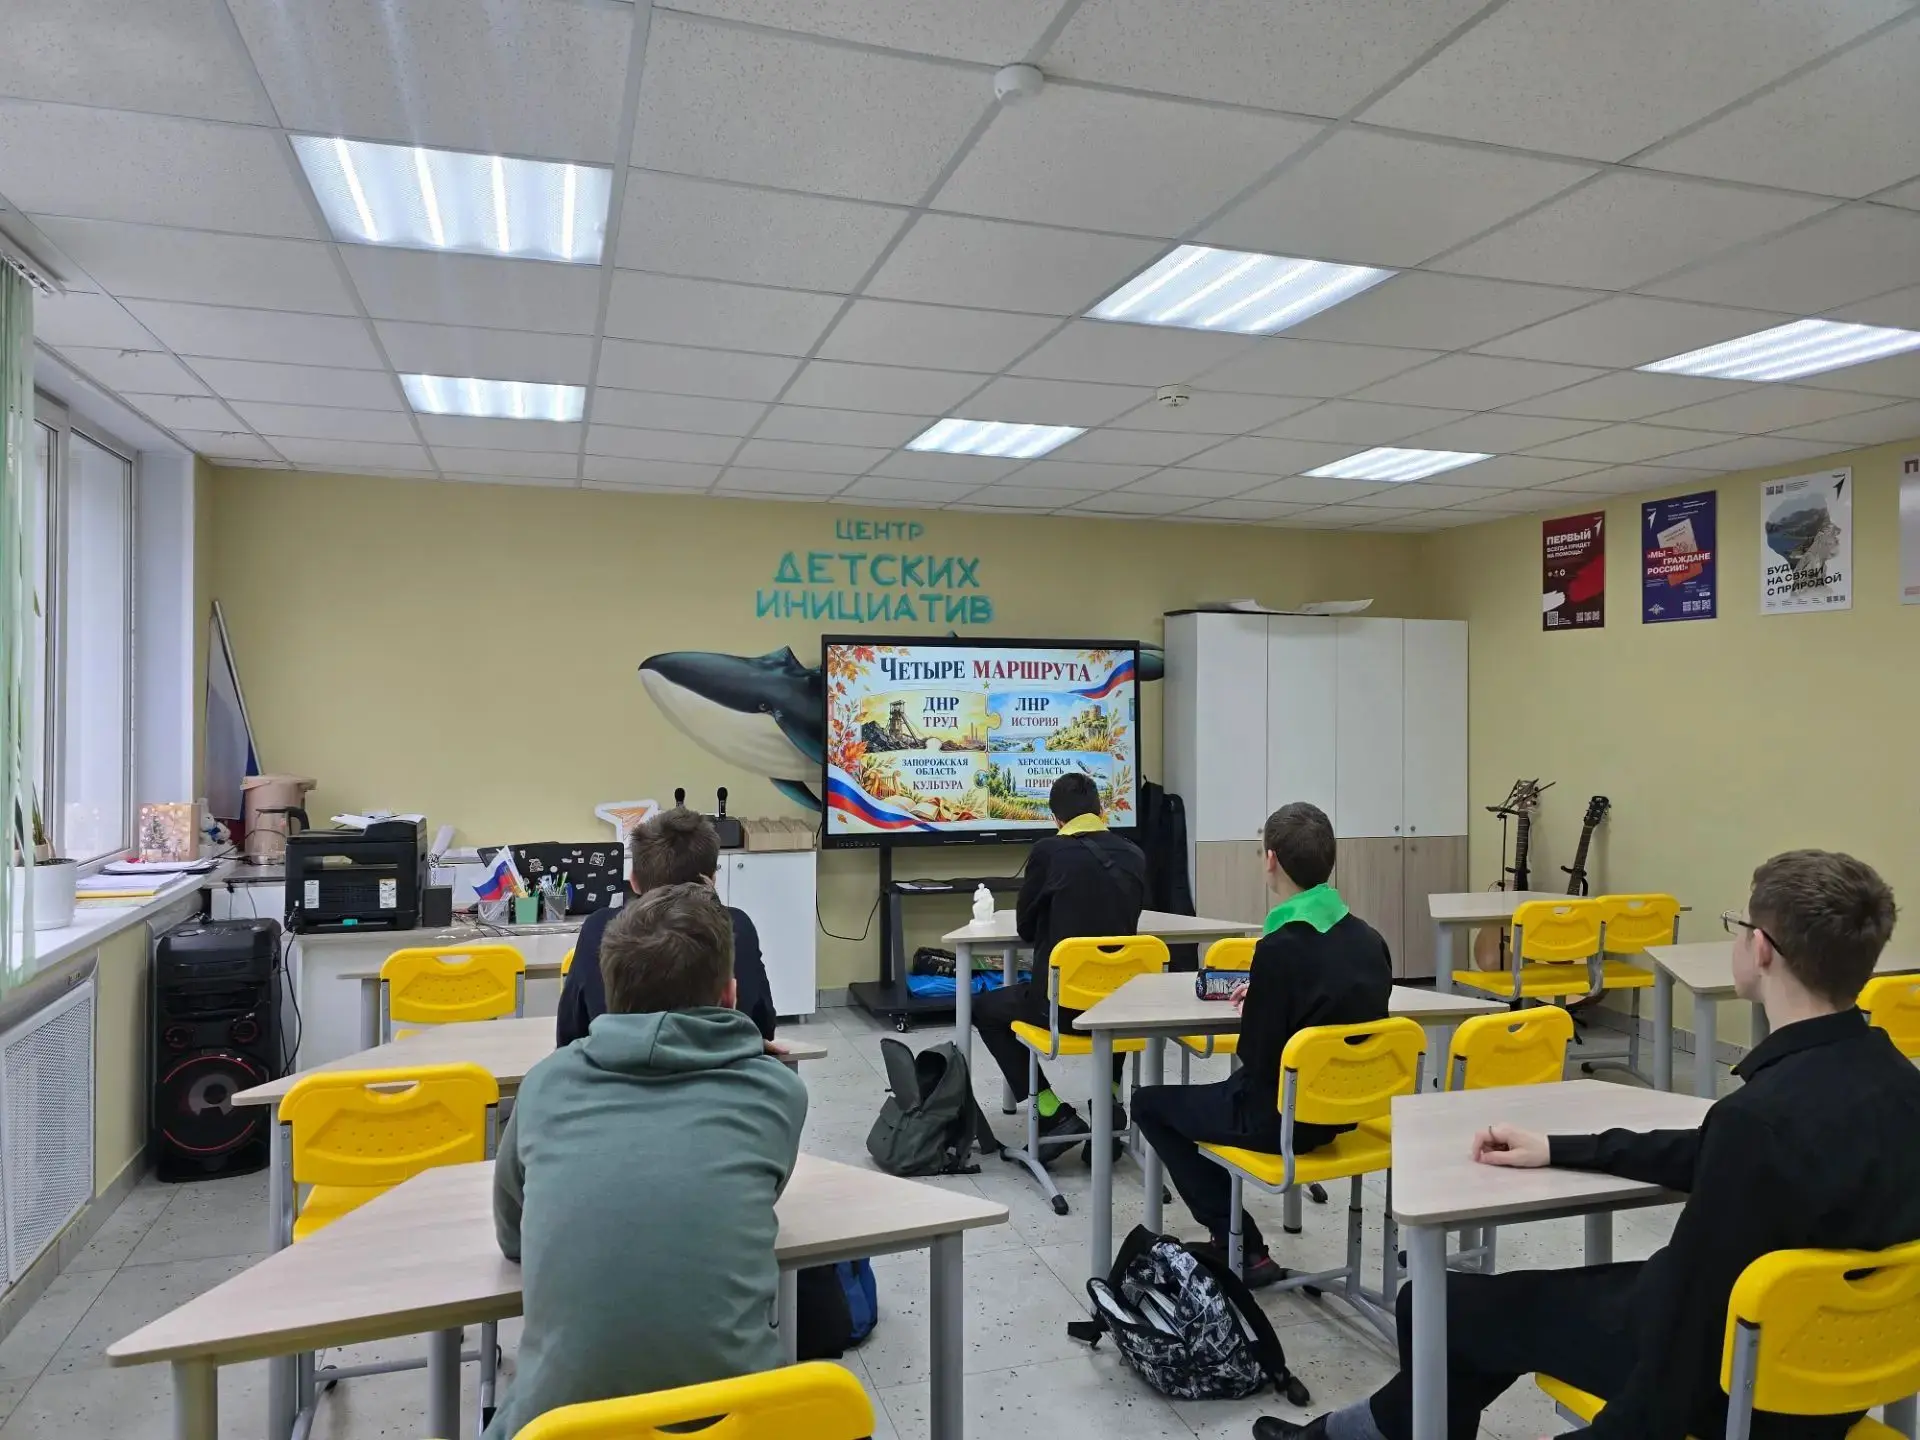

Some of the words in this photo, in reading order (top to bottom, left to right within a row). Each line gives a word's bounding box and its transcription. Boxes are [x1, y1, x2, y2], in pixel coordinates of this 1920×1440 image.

[835, 518, 926, 541] ЦЕНТР
[1547, 528, 1591, 546] ПЕРВЫЙ
[1663, 552, 1711, 565] ГРАЖДАНЕ
[772, 551, 980, 588] ДЕТСКИХ
[1767, 577, 1783, 586] НА
[1785, 566, 1824, 582] СВЯЗИ
[1767, 588, 1775, 596] С
[1777, 572, 1842, 595] ПРИРОДОЙ
[756, 589, 996, 624] ИНИЦИАТИВ
[880, 657, 966, 681] ЧЕТЫРЕ
[973, 660, 1091, 682] МАРШРУТА
[923, 697, 960, 713] ДНР
[1015, 697, 1050, 711] ЛНР
[923, 716, 959, 730] ТРУД
[1011, 717, 1059, 727] ИСТОРИЯ
[902, 758, 969, 767] ЗАПОРОЖСКАЯ
[1018, 758, 1071, 767] ХЕРСОНСКАЯ
[915, 768, 957, 776] ОБЛАСТЬ
[1027, 767, 1065, 776] ОБЛАСТЬ
[912, 779, 963, 790] КУЛЬТУРА
